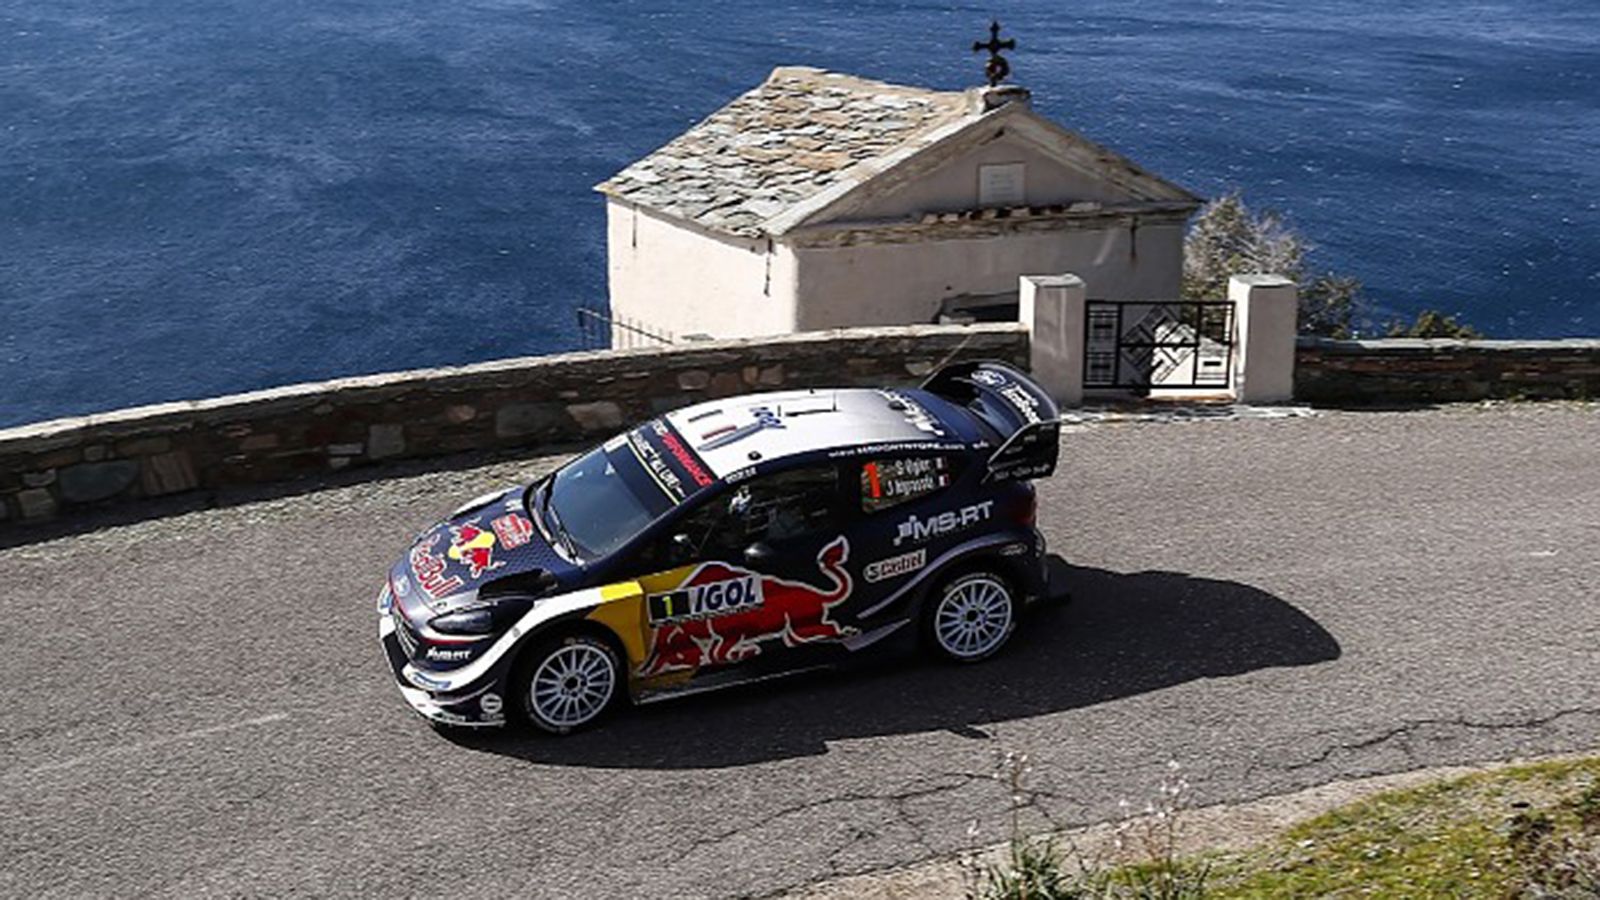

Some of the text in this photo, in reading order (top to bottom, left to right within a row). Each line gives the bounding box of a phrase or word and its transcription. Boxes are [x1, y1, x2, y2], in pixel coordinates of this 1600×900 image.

[864, 462, 881, 498] 1
[661, 595, 674, 617] 1
[694, 576, 757, 614] IGOL
